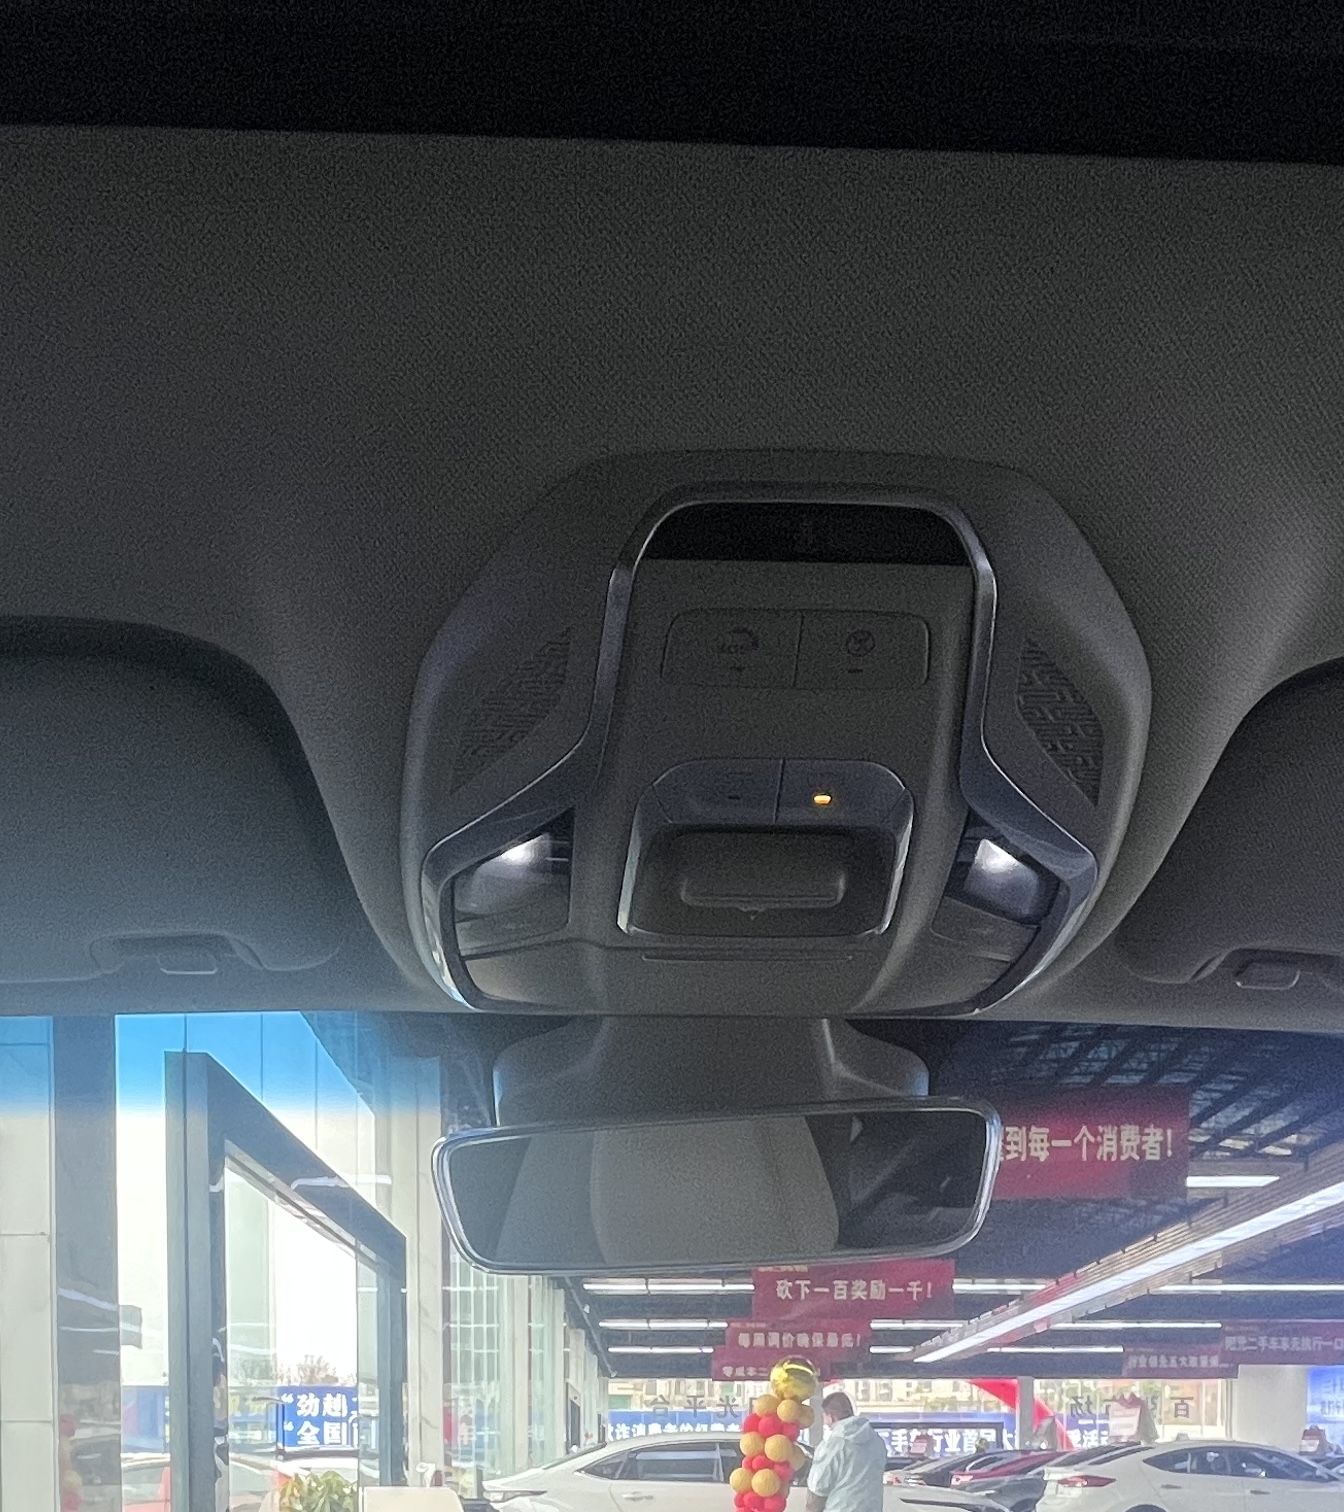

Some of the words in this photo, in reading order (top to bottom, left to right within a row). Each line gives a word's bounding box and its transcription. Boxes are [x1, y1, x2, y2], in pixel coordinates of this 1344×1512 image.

[999, 1125, 1173, 1162] 到每一个消费者!
[776, 1279, 932, 1302] 砍下一百奖励一千!
[284, 1421, 358, 1446] “全国
